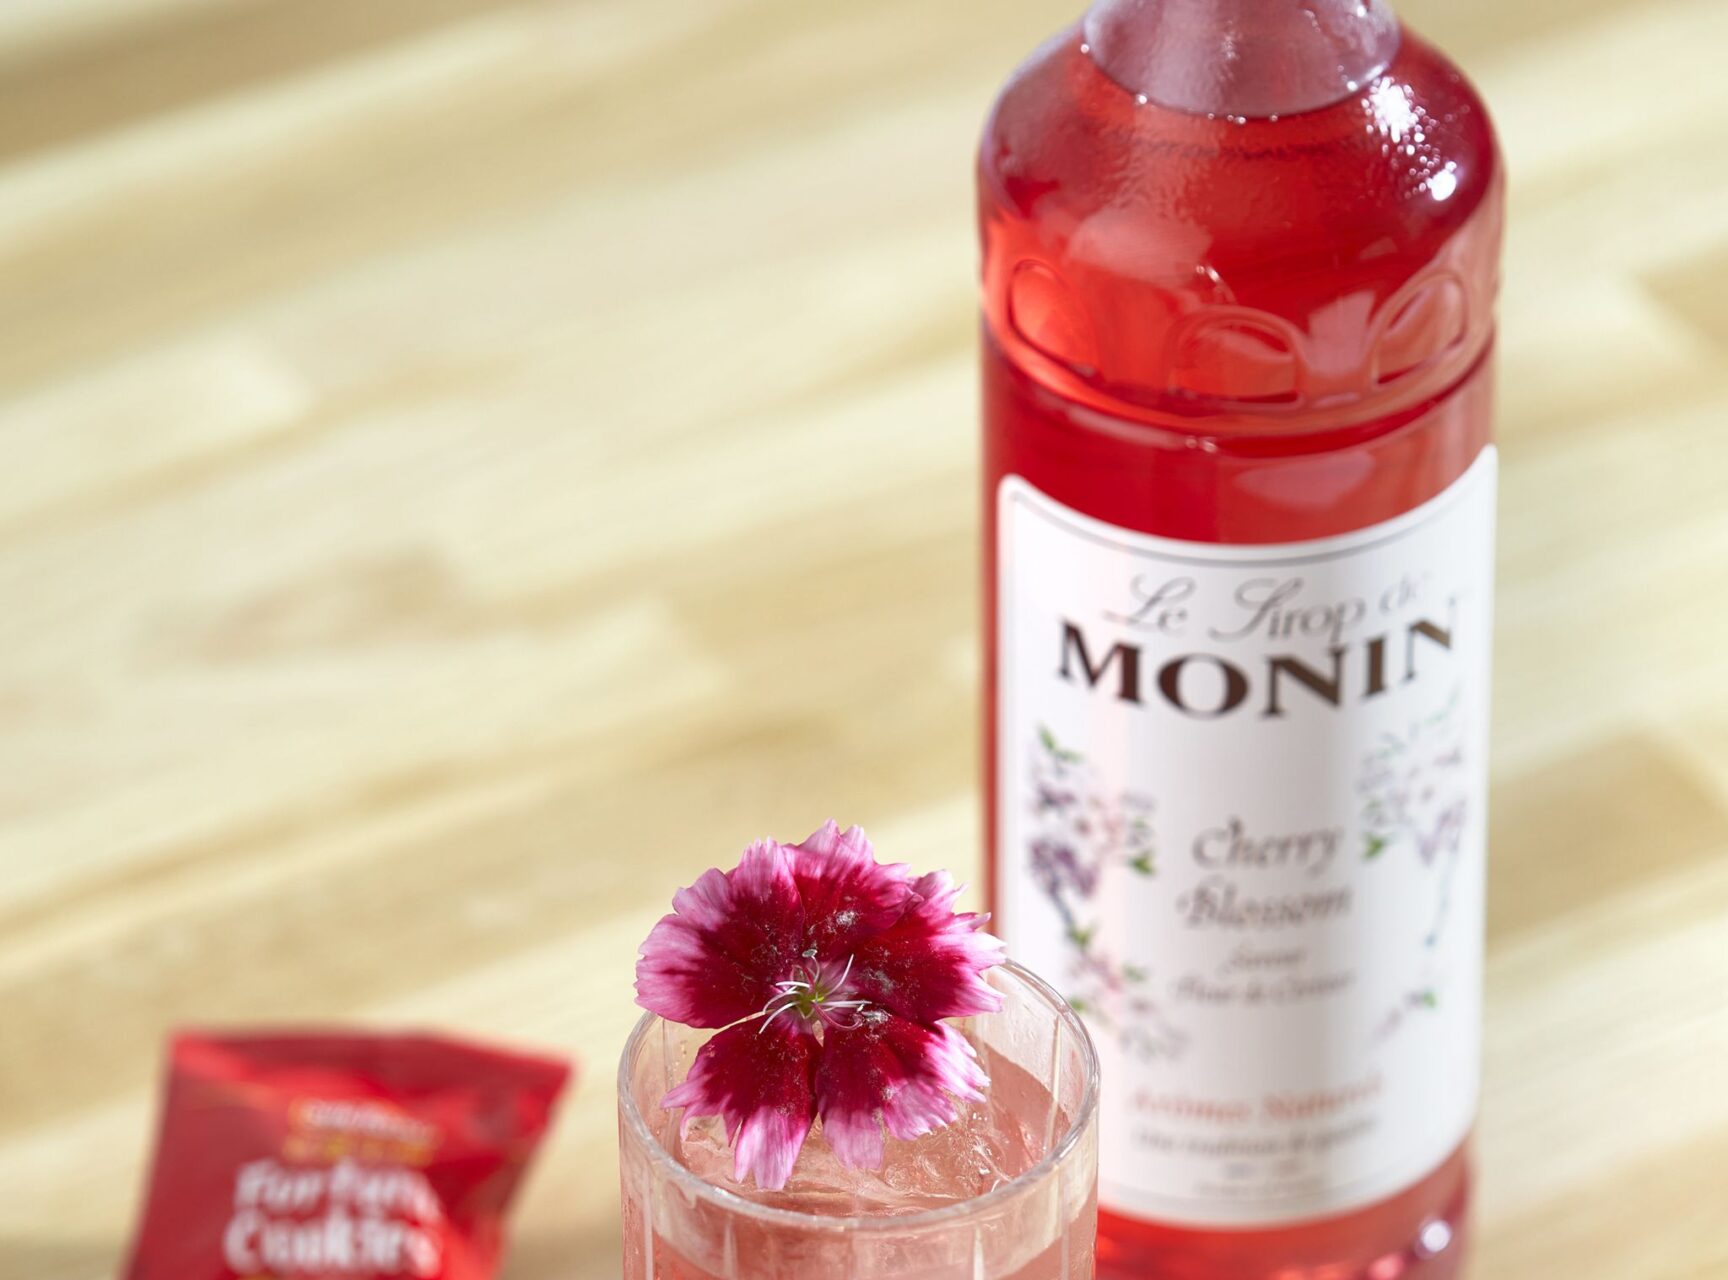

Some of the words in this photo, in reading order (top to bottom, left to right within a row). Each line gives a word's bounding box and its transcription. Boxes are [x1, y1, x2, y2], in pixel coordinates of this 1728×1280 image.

[1103, 573, 1195, 631] Le
[1208, 576, 1366, 643] Sirop
[1057, 597, 1456, 720] MONIN
[1191, 814, 1344, 878] Cherry
